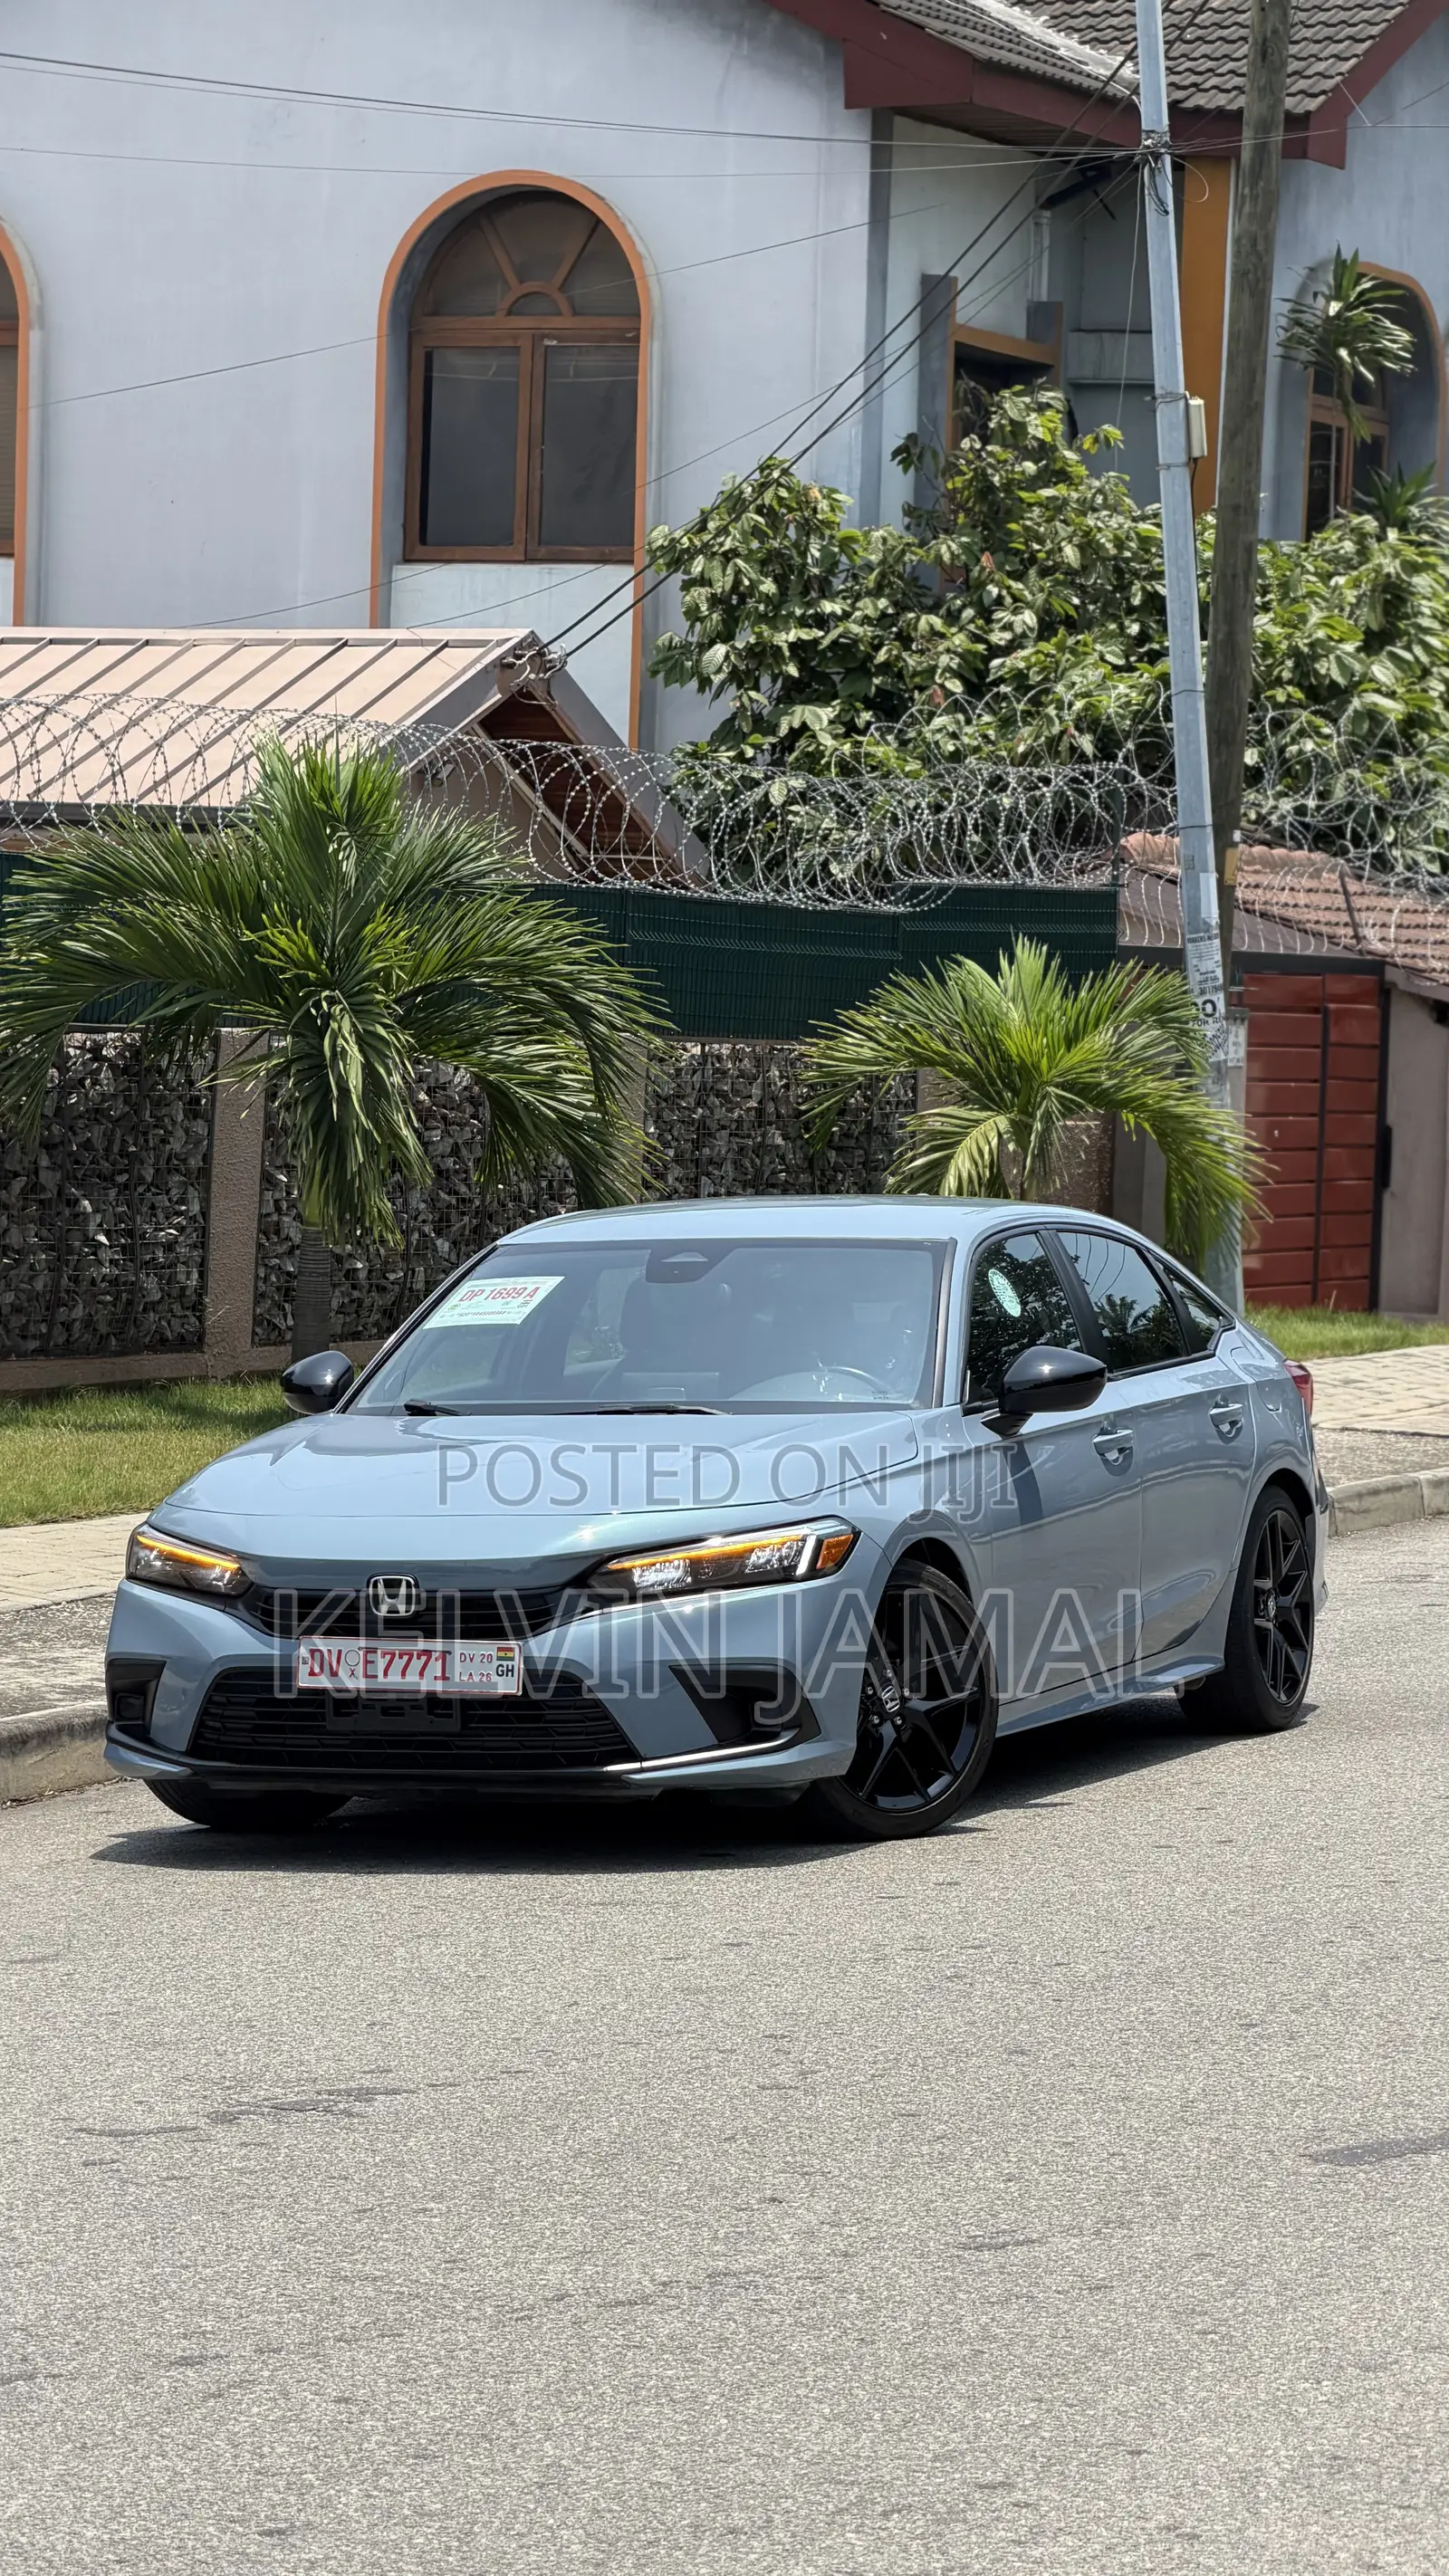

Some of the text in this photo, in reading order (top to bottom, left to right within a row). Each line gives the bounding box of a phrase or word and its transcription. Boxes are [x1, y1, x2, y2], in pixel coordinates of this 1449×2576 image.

[457, 1286, 541, 1302] DP 1699 A
[307, 1648, 342, 1677] DV
[362, 1649, 451, 1681] E7771
[459, 1652, 493, 1663] DV 20
[459, 1671, 492, 1682] LA 26
[495, 1663, 514, 1677] GH
